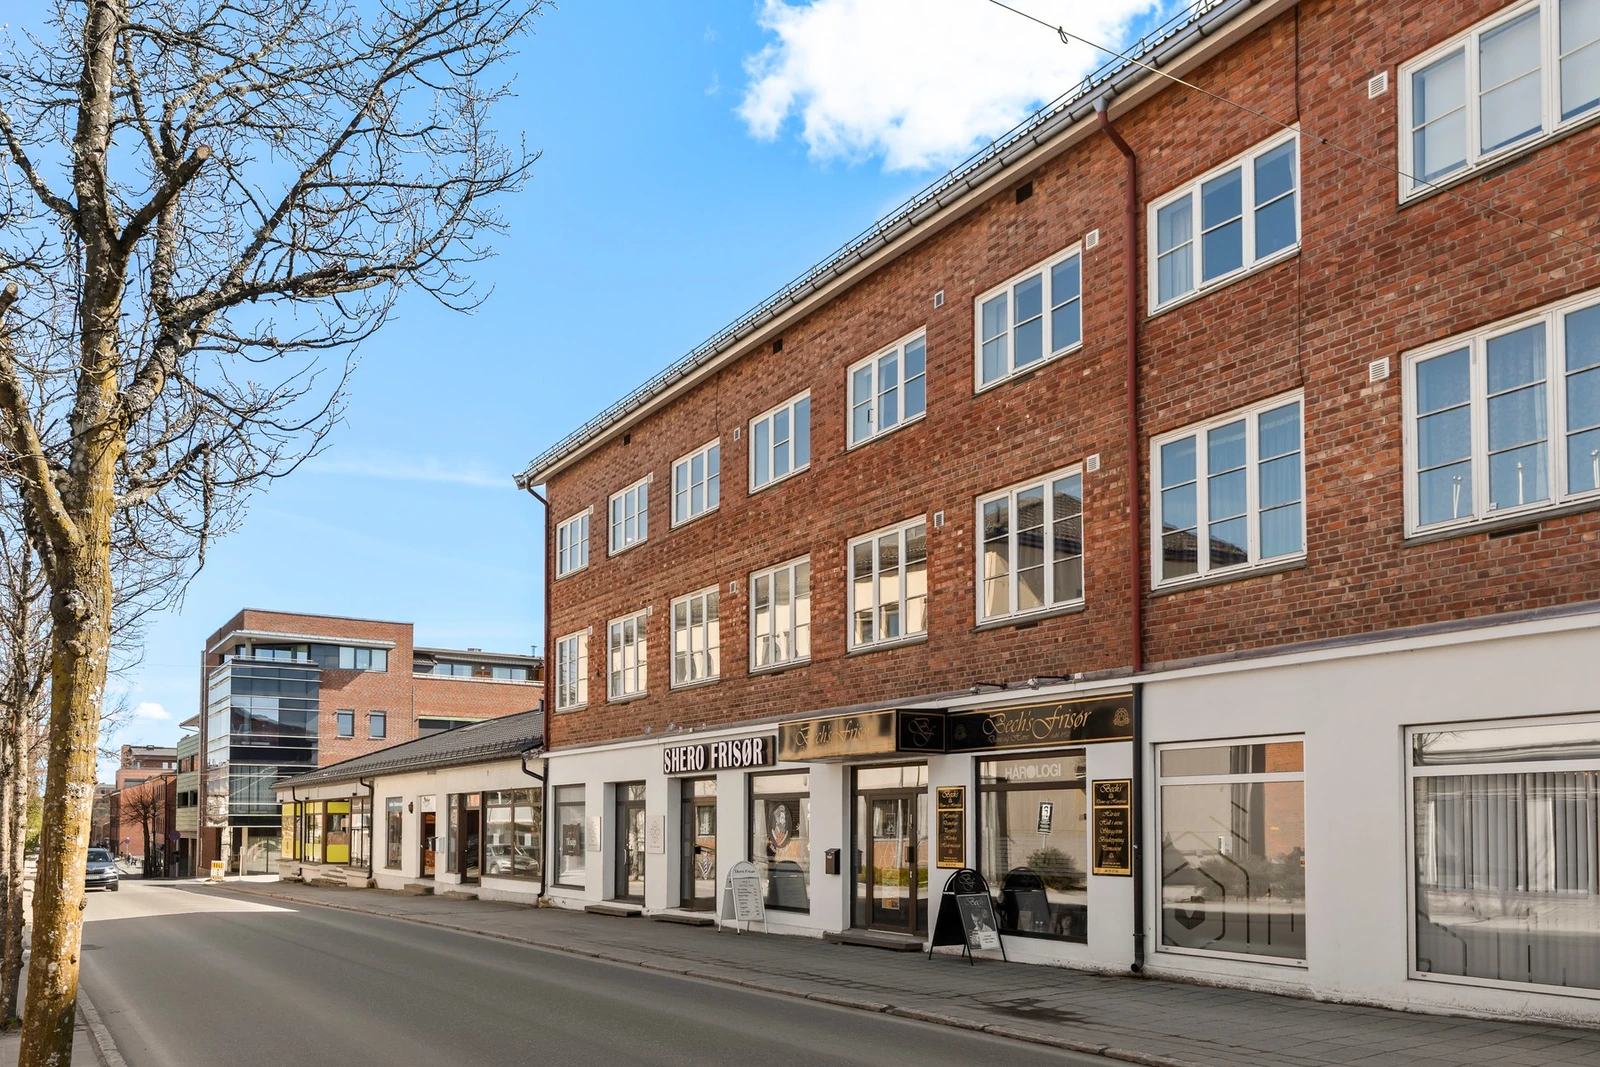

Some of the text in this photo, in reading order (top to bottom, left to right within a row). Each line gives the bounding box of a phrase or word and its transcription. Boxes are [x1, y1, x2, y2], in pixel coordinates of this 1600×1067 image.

[982, 704, 1092, 739] Bech's Frisør
[664, 738, 763, 773] SHERO FRISØR
